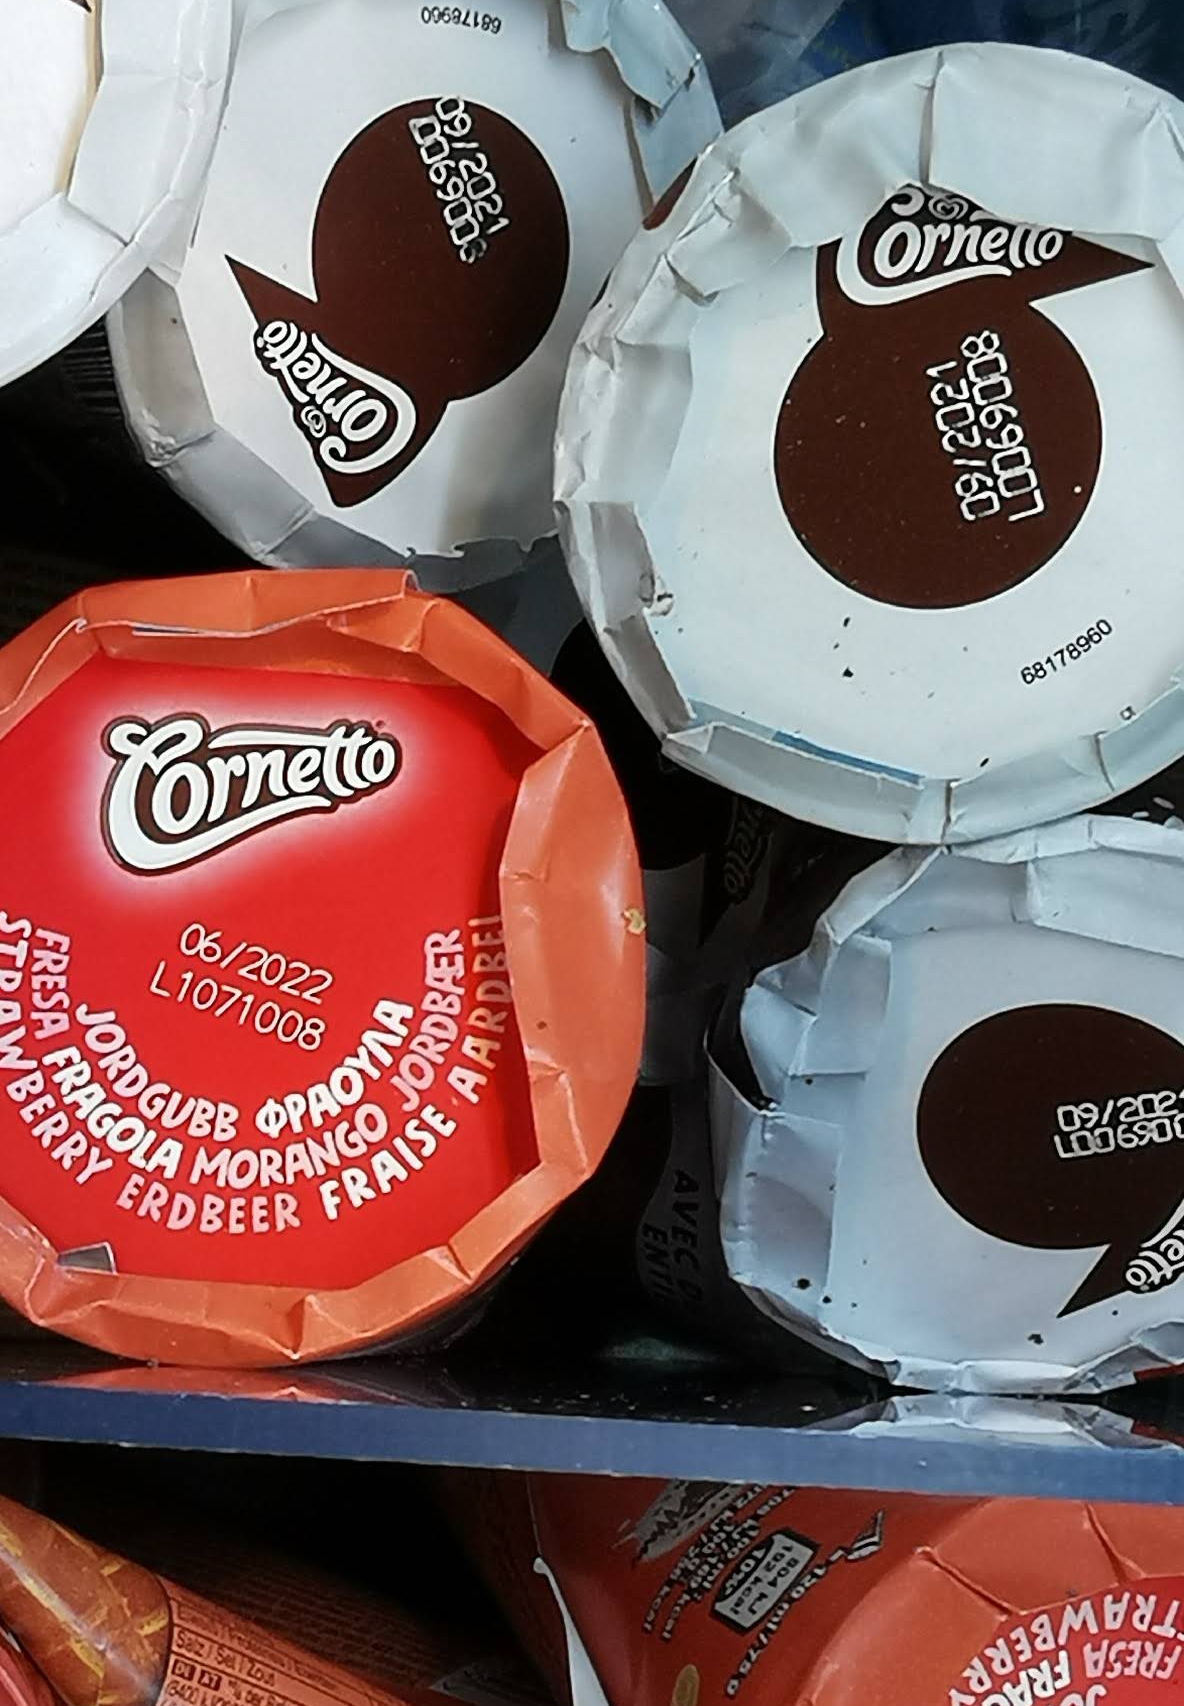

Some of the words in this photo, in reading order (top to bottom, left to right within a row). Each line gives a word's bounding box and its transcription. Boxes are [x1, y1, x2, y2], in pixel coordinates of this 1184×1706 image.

[434, 94, 510, 237] 09/2021
[836, 185, 1066, 307] Cornetto
[256, 319, 416, 474] Cornetto
[926, 359, 1001, 522] 09/2021
[960, 329, 1045, 523] L0069008
[1019, 616, 1114, 687] 68178960
[105, 715, 401, 873] Cornetto
[29, 928, 71, 1040] FRESA
[149, 961, 326, 1051] L1071008
[180, 922, 334, 1005] 06/2022
[388, 928, 466, 1113] JORDBÆR
[42, 1046, 184, 1181] FRAGOLA
[76, 1002, 239, 1140] JORDGUBB
[116, 1174, 302, 1234] ERDBEER
[319, 1102, 458, 1221] FRAISE
[189, 1102, 389, 1190] MORANGO
[1082, 1637, 1183, 1681] FRESA
